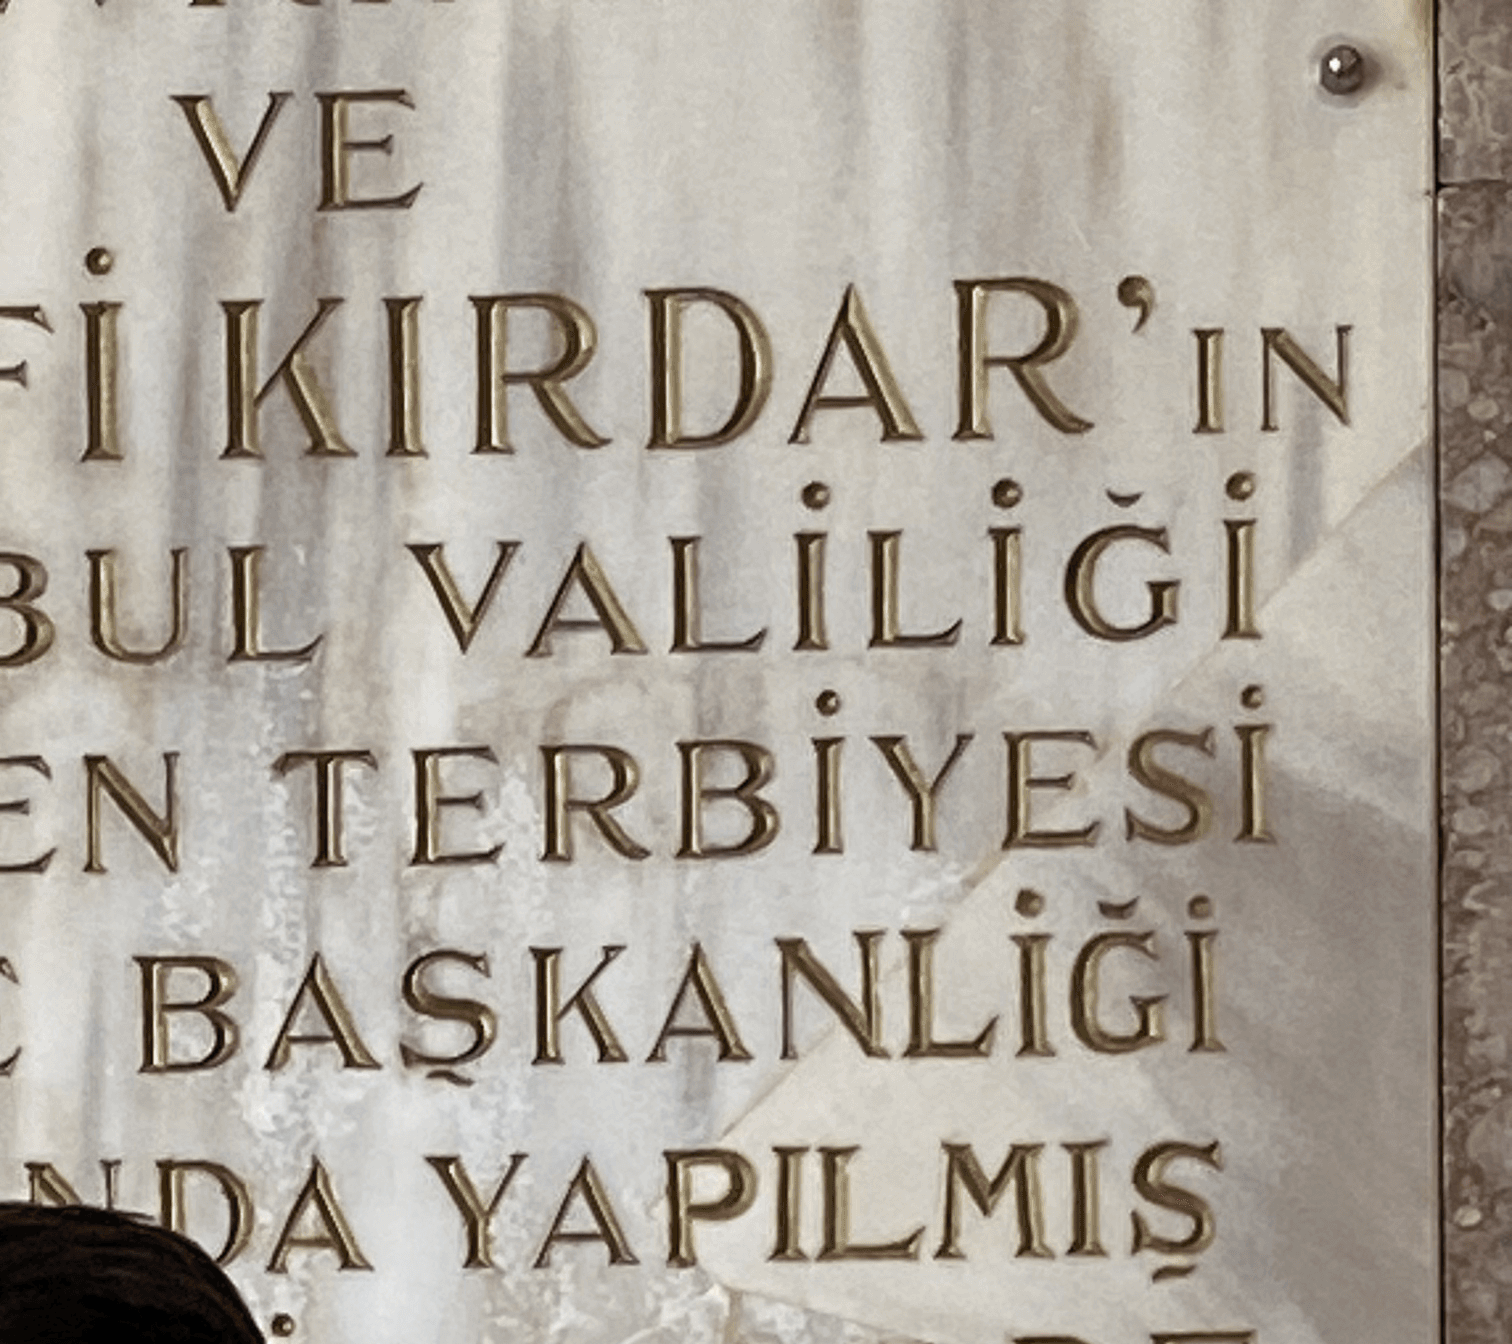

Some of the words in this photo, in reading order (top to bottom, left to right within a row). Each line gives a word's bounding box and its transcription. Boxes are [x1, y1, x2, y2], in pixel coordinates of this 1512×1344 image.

[169, 88, 425, 213] VE
[404, 470, 1265, 659] VALİLİĞİ
[271, 684, 1278, 869] TERBİYESİ
[424, 1138, 1224, 1283] YAPILMIŞ
